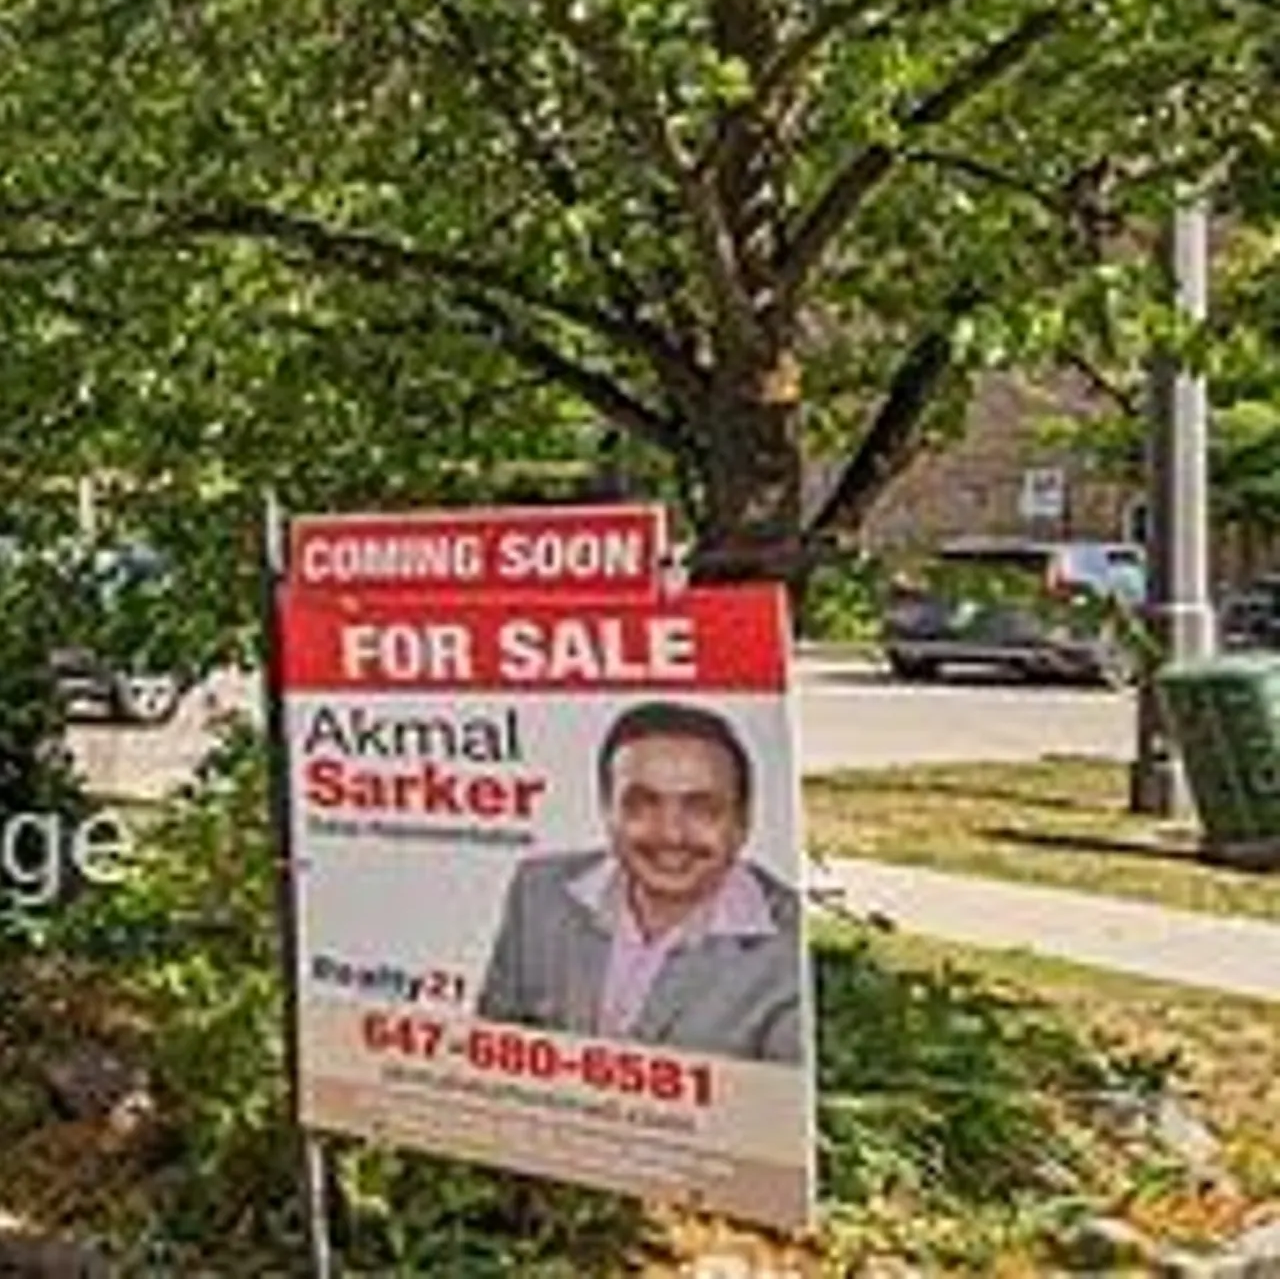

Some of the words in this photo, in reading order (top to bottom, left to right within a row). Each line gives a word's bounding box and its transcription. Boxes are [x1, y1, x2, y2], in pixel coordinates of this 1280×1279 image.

[302, 535, 483, 582] COMING
[498, 527, 643, 577] SOON
[341, 625, 472, 678] FOR
[499, 619, 697, 677] SALE
[304, 705, 519, 762] Akmal
[304, 760, 545, 816] Sarker
[362, 1010, 712, 1107] 647-680-6581
